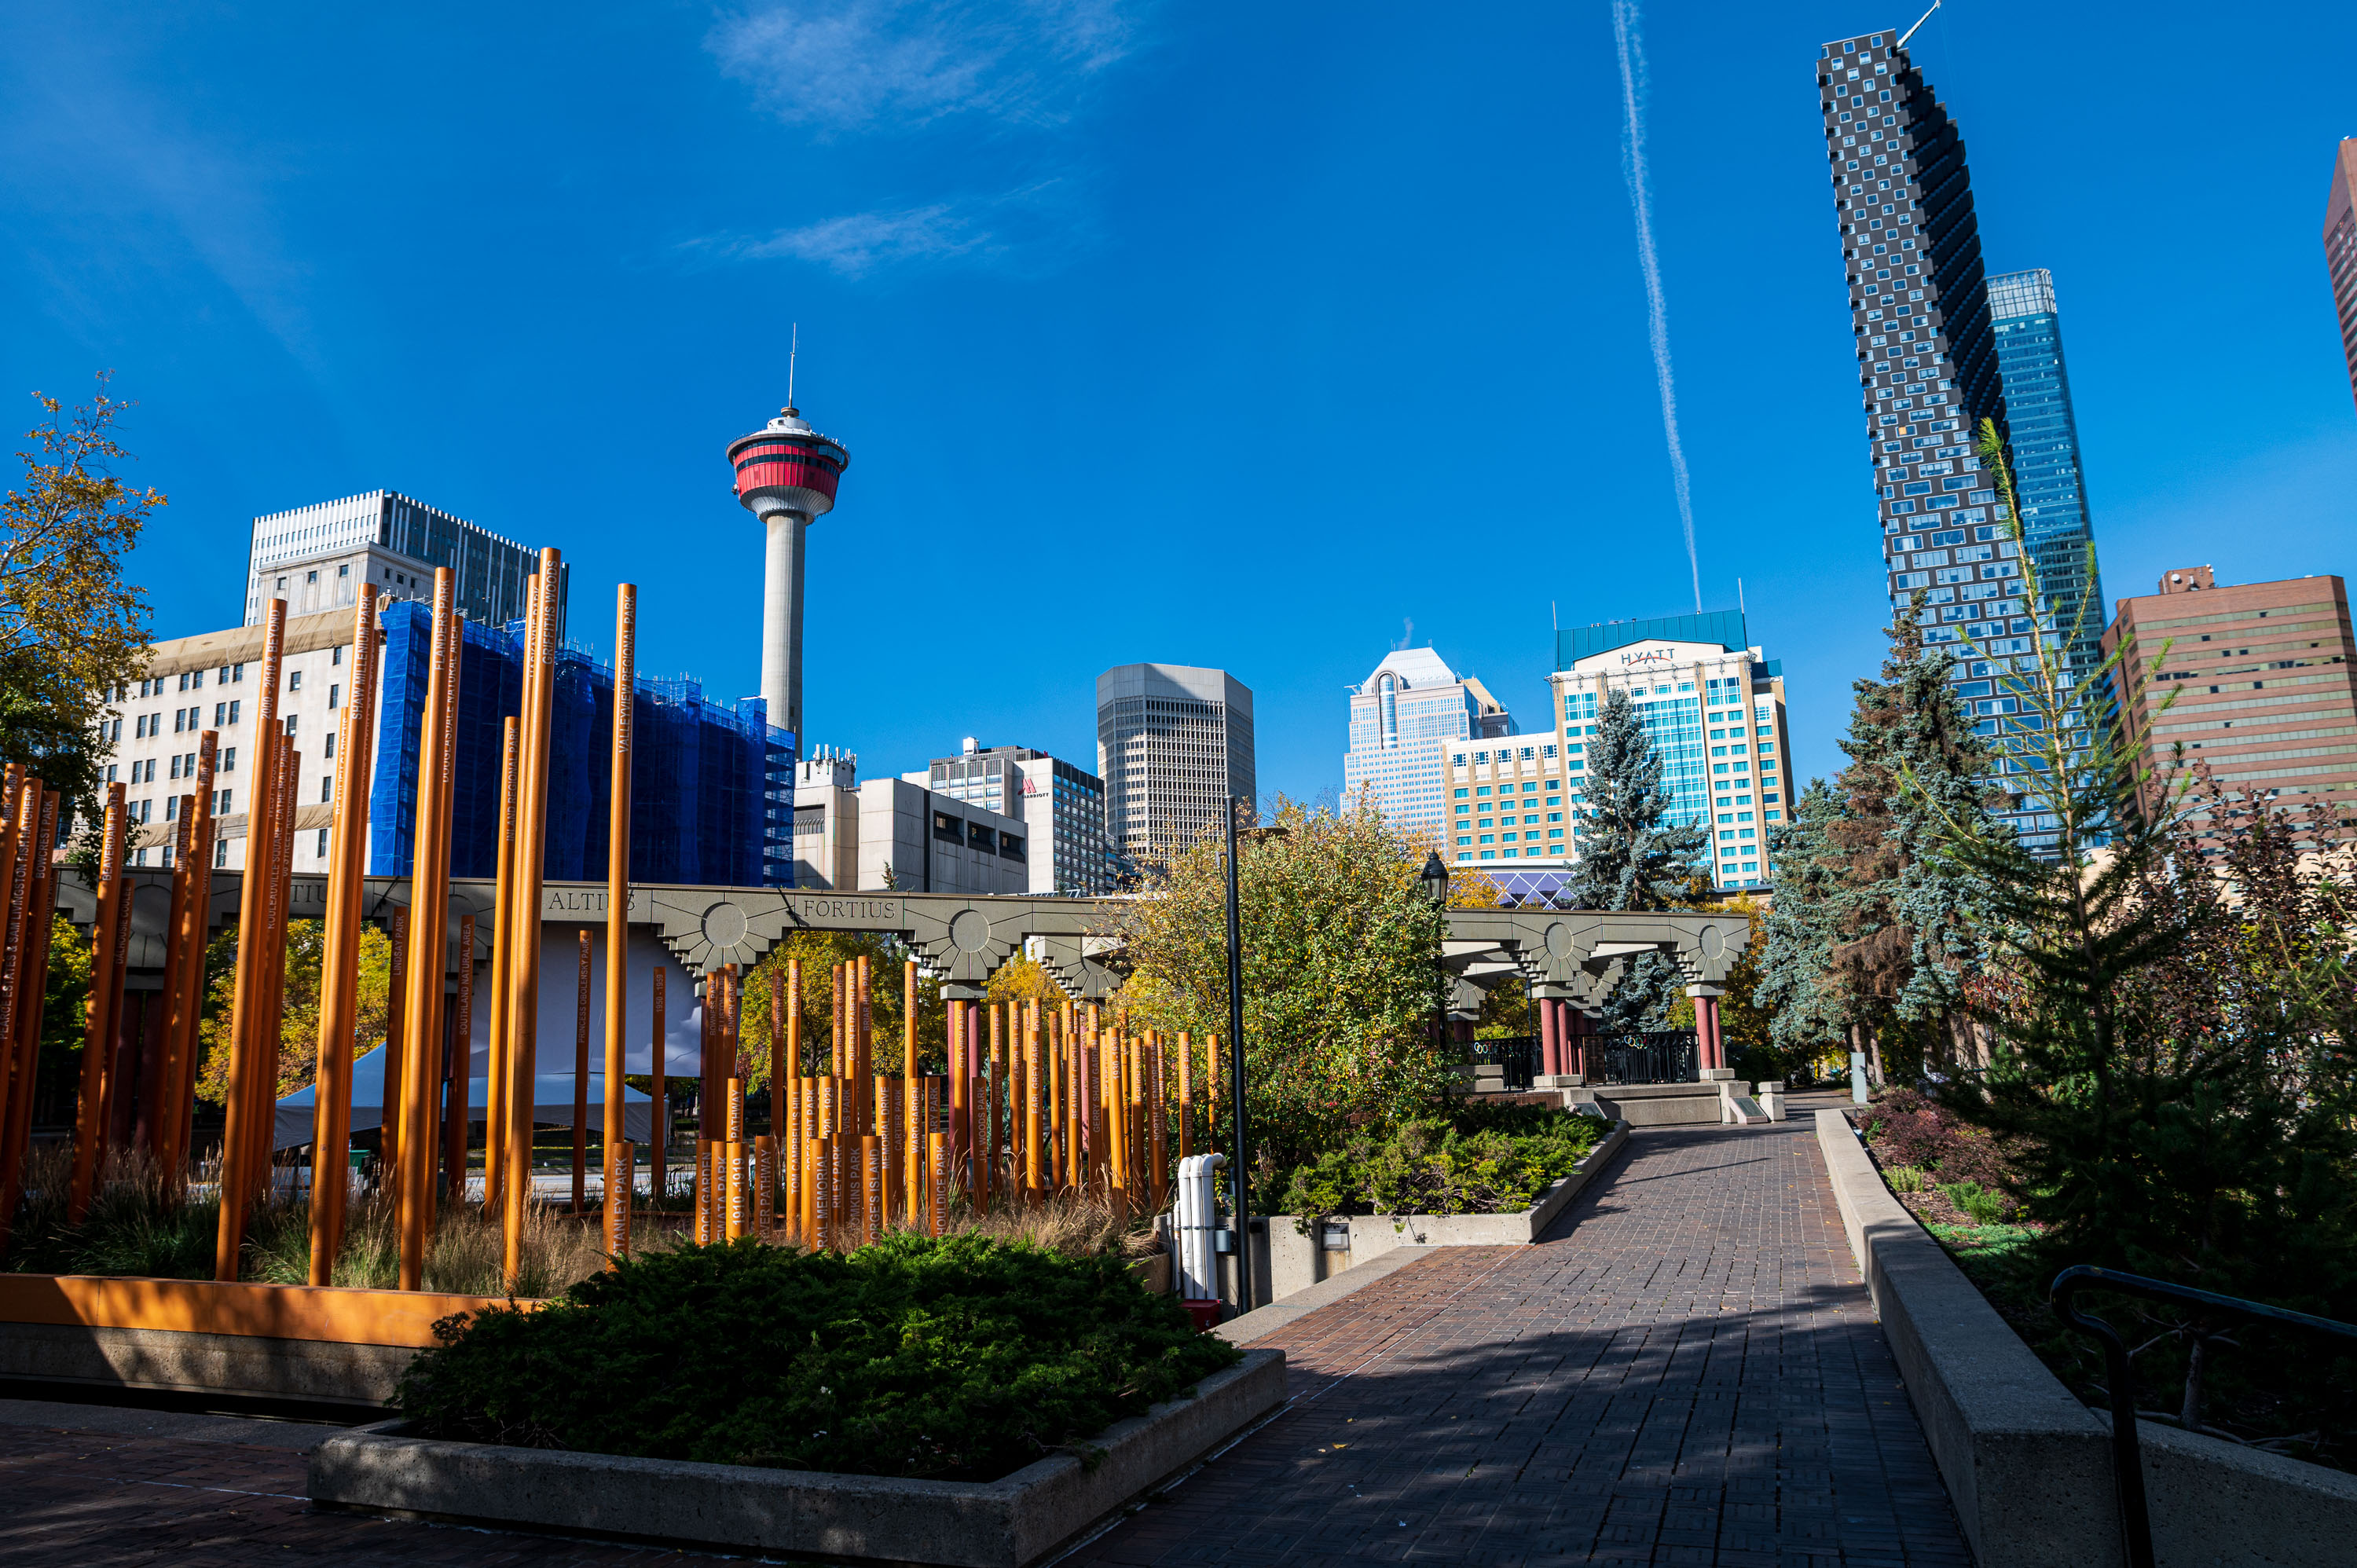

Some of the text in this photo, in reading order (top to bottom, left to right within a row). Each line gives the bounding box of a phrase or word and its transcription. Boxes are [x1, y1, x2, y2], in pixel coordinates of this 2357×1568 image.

[268, 610, 280, 653] BEYOND
[361, 595, 372, 624] PARK
[434, 580, 450, 670] FLANDERS PARK
[542, 560, 558, 665] GRIFFITHS WOODS
[264, 665, 275, 689] 2010
[355, 626, 370, 685] MILLENIUM
[618, 595, 635, 753] VALLEYVIEW REGIONAL PARK
[1621, 649, 1675, 665] HYATT
[261, 696, 273, 720] 2000
[352, 688, 365, 720] SHAW
[442, 626, 460, 783] DOUGLASDALE NATURAL AREA
[200, 740, 213, 786] 1990 1999
[506, 727, 519, 841] INLAND REGIONAL PARK
[2, 774, 18, 822] 1980 1989
[21, 788, 35, 838] HATCHERY
[42, 800, 53, 825] PARK
[19, 840, 31, 861] FISH
[36, 828, 50, 878] BOWCREST
[101, 792, 119, 881] BEAVERDAM FLATS
[177, 804, 192, 873] NIMMONS PARK
[268, 744, 288, 929] ROULEAUVILLE SQUARE CATHEDRAL PARK
[14, 863, 28, 920] LIVINGSTON
[804, 900, 895, 919] FORTIUS
[10, 945, 20, 954] &
[12, 921, 22, 943] SAM
[116, 887, 133, 964] DALHOUSIE COULEE
[393, 915, 404, 976] LINDSAY PARK
[5, 954, 19, 998] ESTATES
[460, 923, 471, 1035] SOUTHLAND NATURAL AREA
[580, 960, 588, 1005] OBOLENSKY
[578, 1006, 587, 1043] PRINCESS
[731, 1090, 742, 1138] PATHWAY
[807, 1089, 816, 1116] PARK
[824, 1087, 834, 1109] 1929
[792, 1112, 801, 1172] CAMPBELL'S
[842, 1116, 851, 1135] EVIS
[881, 1086, 890, 1169] MEMORIAL DRIVE
[761, 1149, 772, 1208] PATHWAY
[791, 1174, 800, 1194] TOM
[832, 1145, 842, 1209] RILEY PARK
[850, 1147, 860, 1178] PARK
[870, 1149, 880, 1190] ISLAND
[613, 1157, 627, 1257] STANLEY PARK
[702, 1152, 711, 1242] ROCK GARDEN
[733, 1196, 745, 1225] 1910
[817, 1152, 828, 1248] RAL MEMORIAL
[937, 1145, 946, 1236] HOULDICE PARK
[717, 1194, 726, 1240] EWATA
